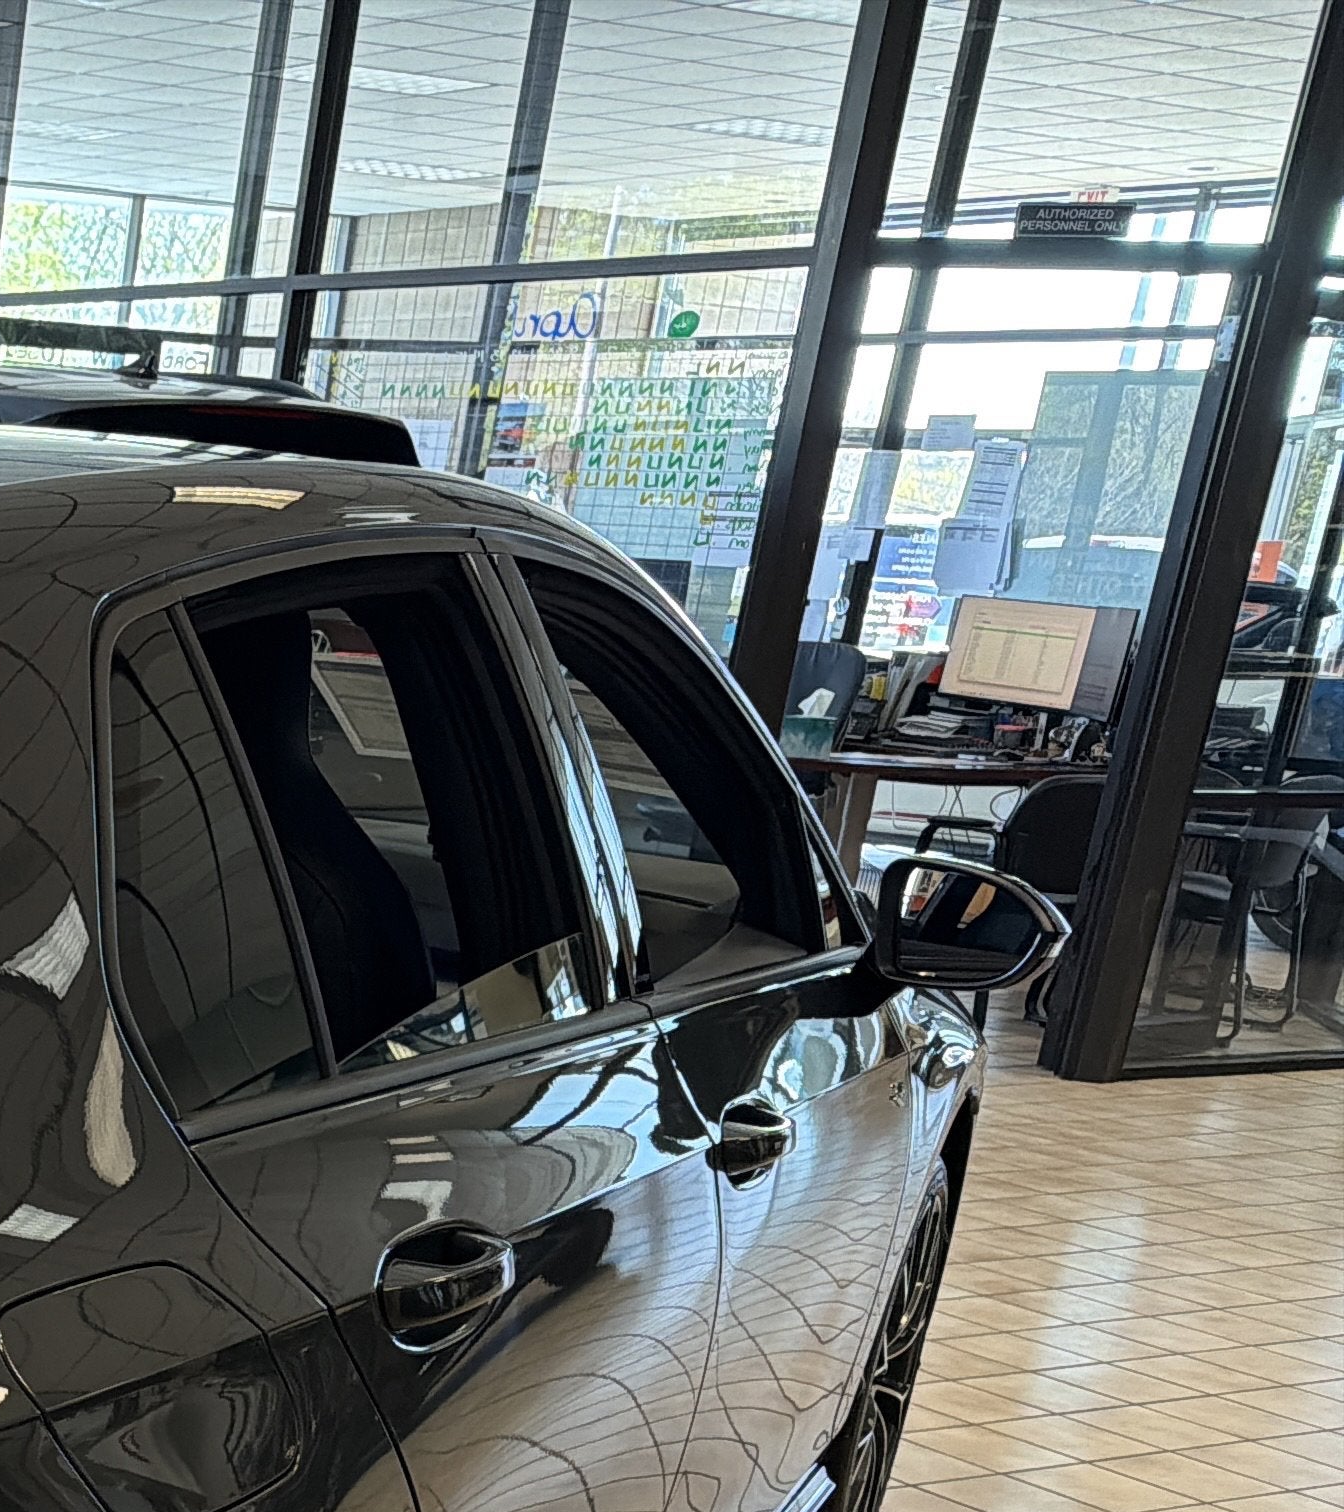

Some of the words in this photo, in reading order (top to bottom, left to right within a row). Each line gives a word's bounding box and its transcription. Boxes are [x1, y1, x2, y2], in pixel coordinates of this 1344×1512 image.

[1036, 208, 1115, 220] AUTHORIZED
[1019, 220, 1091, 231] PERSONNEL
[1094, 221, 1127, 232] ONLY
